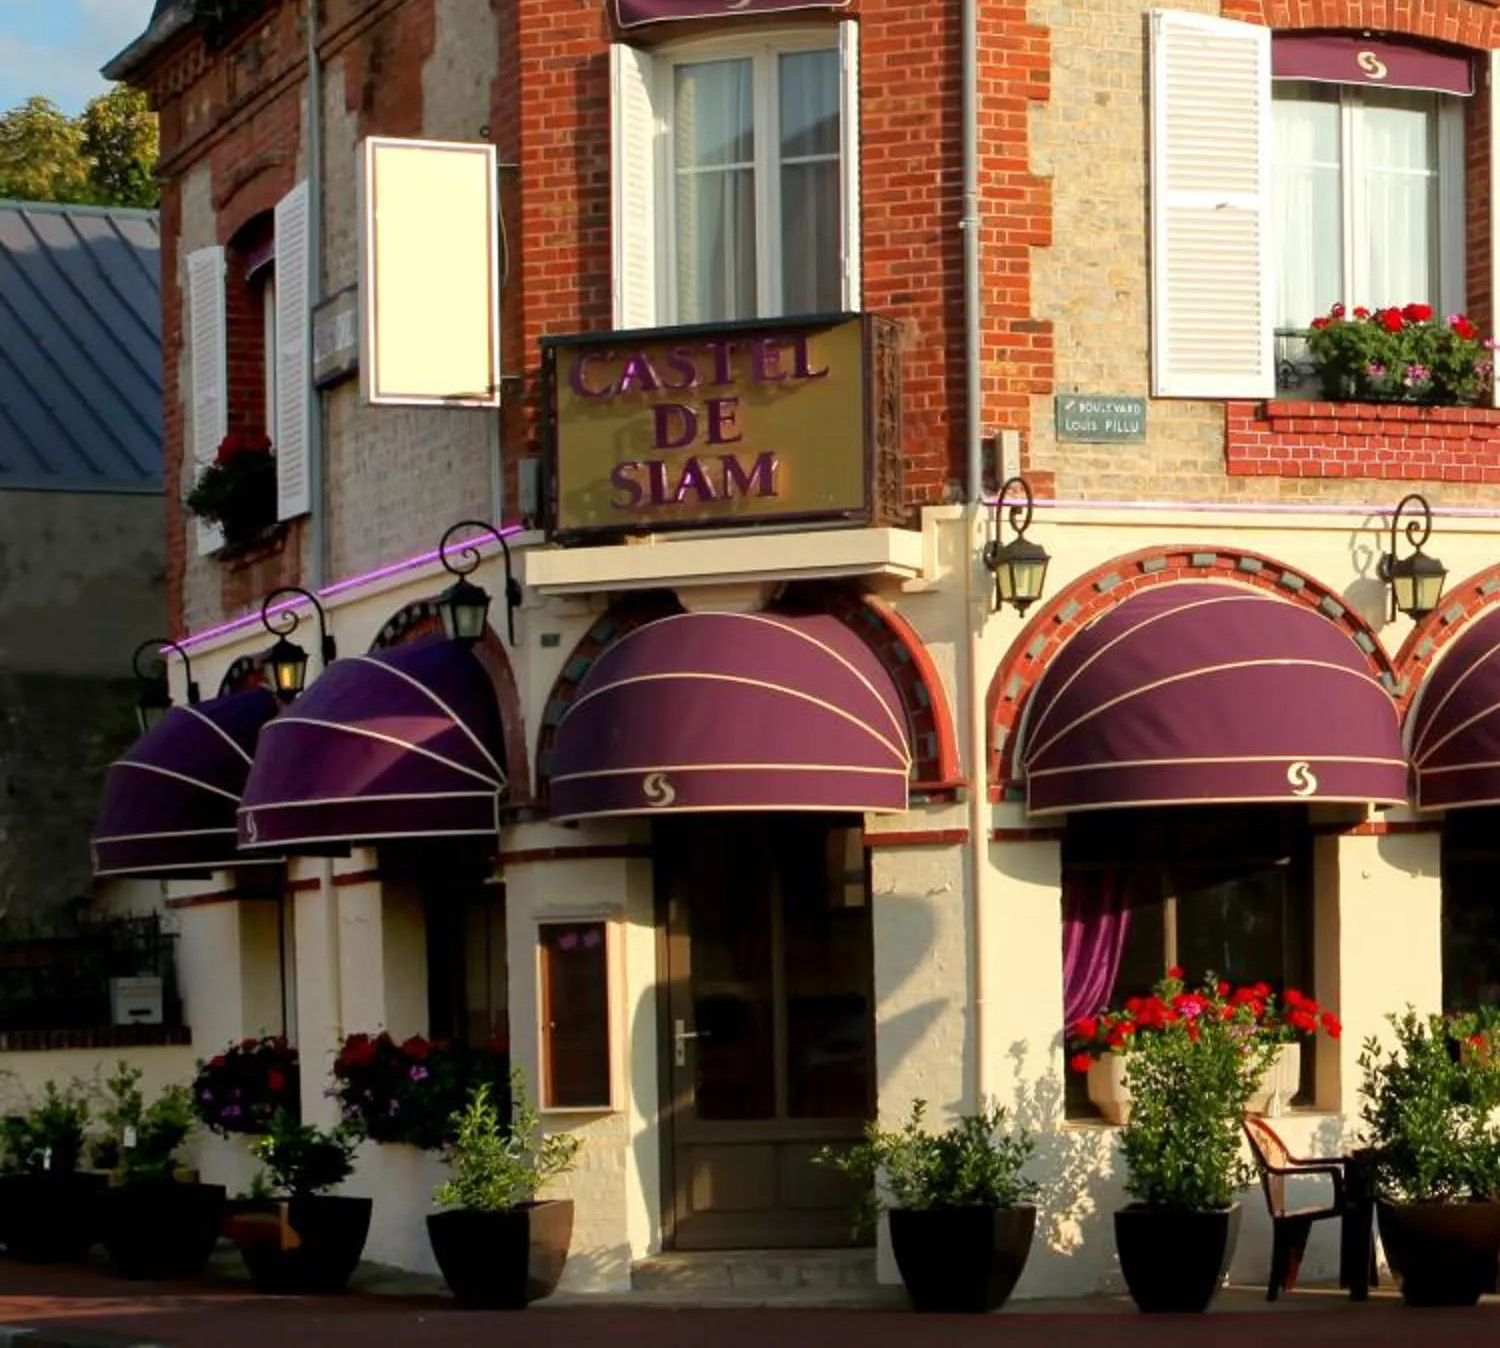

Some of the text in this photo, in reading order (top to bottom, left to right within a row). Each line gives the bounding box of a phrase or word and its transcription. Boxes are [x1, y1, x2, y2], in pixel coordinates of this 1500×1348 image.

[568, 329, 829, 400] CASTEL
[652, 396, 744, 450] DE
[610, 451, 780, 510] SIAM
